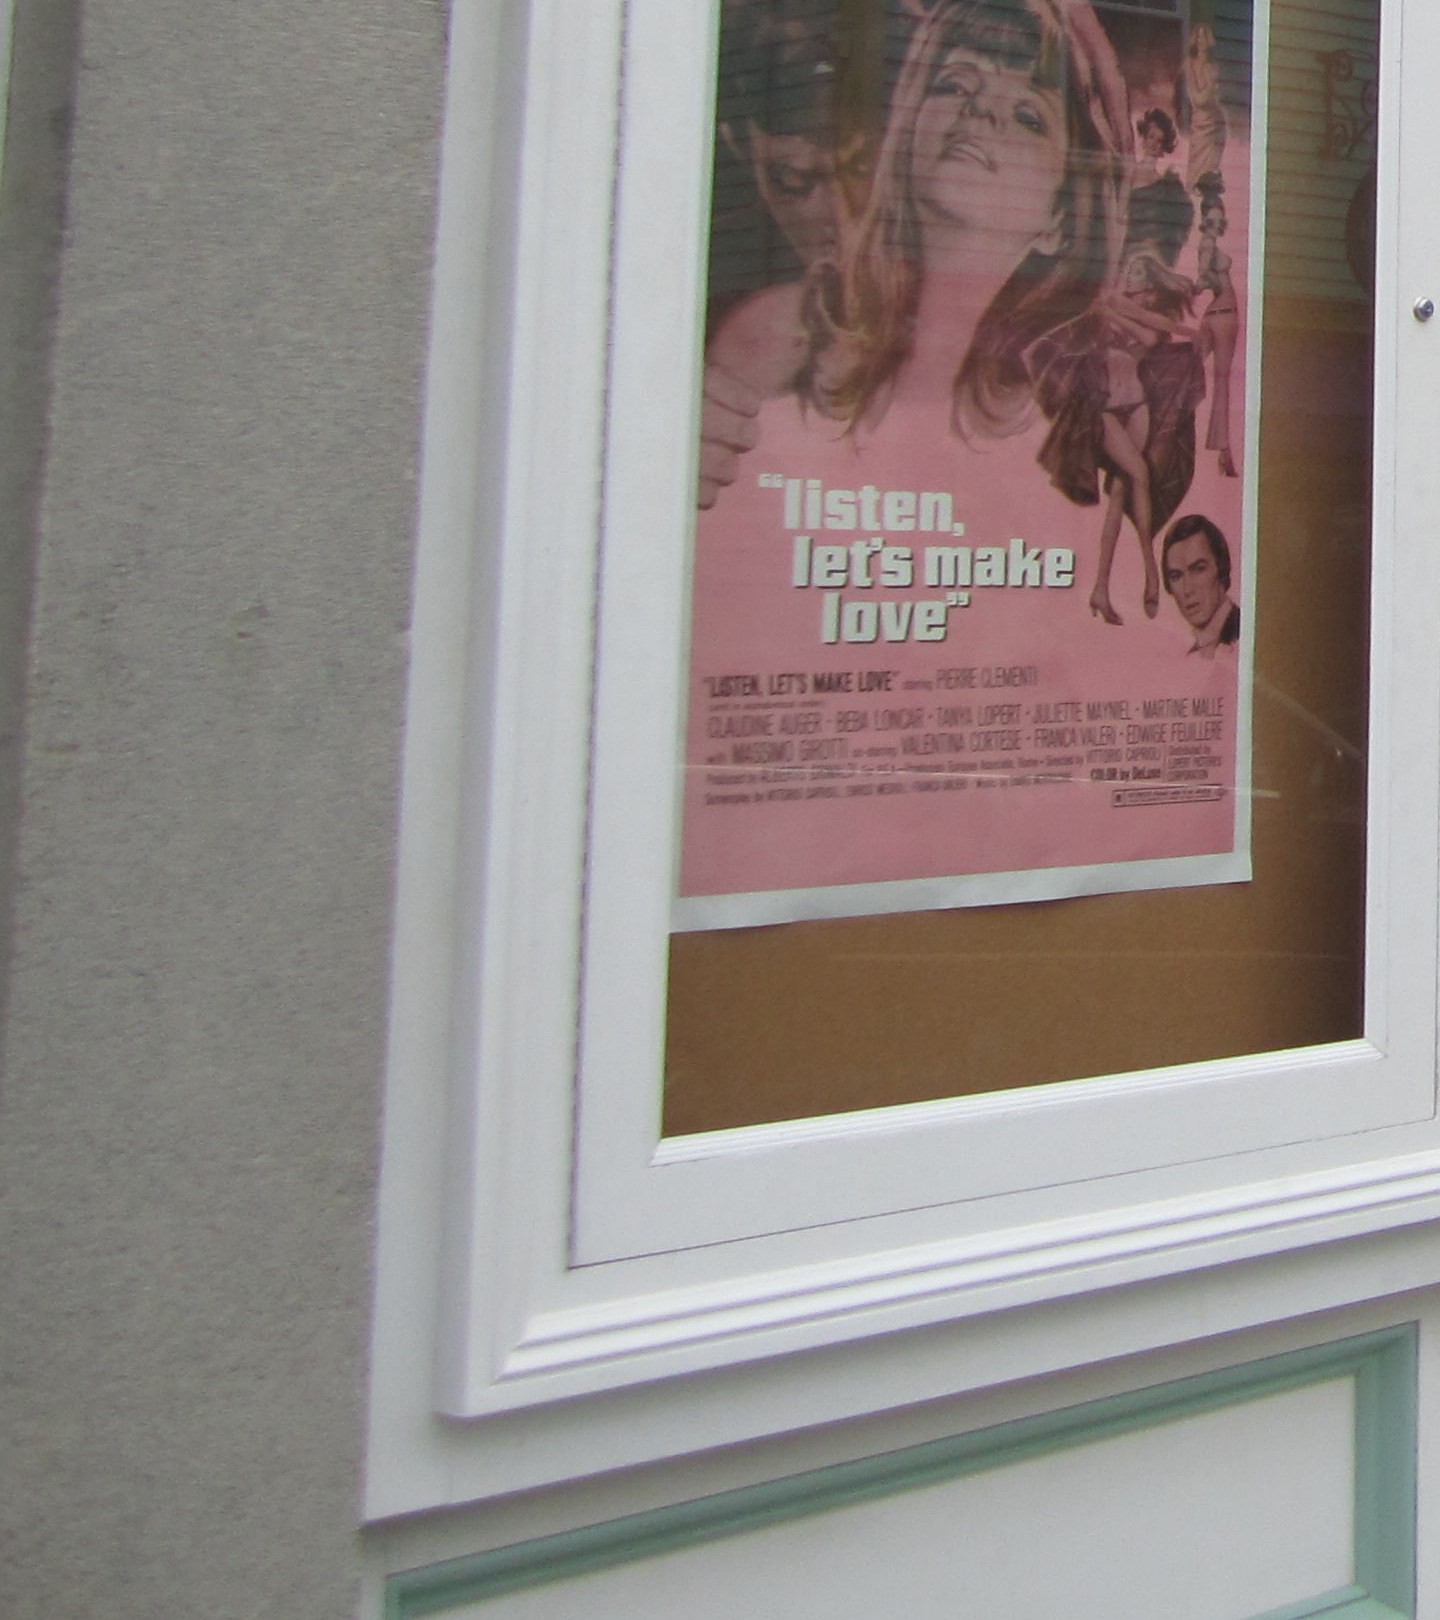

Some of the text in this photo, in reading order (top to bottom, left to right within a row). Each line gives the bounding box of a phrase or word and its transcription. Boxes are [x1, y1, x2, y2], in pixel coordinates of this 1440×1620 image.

[792, 537, 1075, 588] let's make
[822, 591, 971, 644] love"
[769, 672, 807, 696] LET'S
[813, 671, 852, 694] MAKE
[1142, 698, 1188, 718] MARTINE
[1192, 697, 1224, 717] MALLE
[1127, 723, 1168, 744] EDWIGE
